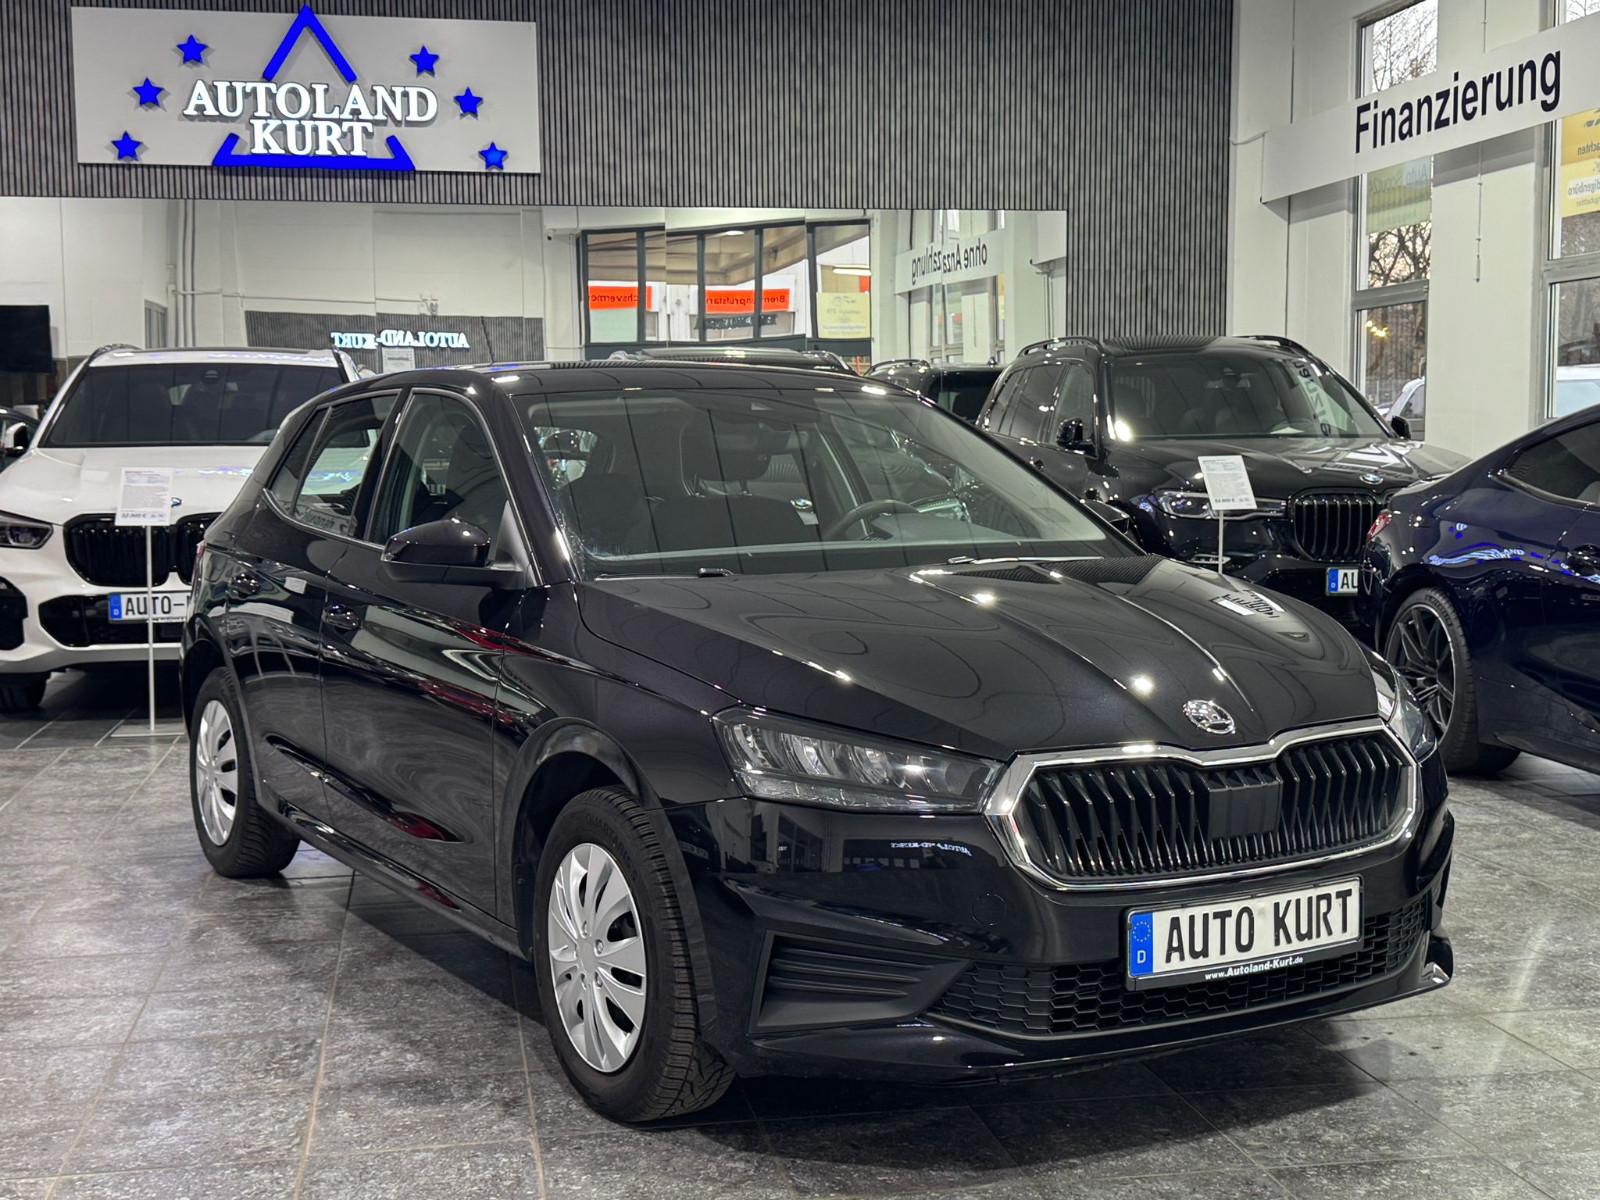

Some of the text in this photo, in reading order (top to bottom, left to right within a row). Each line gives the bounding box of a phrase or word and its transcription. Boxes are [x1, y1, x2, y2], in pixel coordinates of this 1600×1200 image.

[182, 79, 439, 123] AUTOLAND
[1354, 49, 1562, 154] Finanzierung
[249, 117, 375, 158] KURT
[113, 608, 120, 616] D
[1137, 888, 1353, 964] D AUTO KURT
[1204, 956, 1304, 980] www.Autoland-Kurt.de
